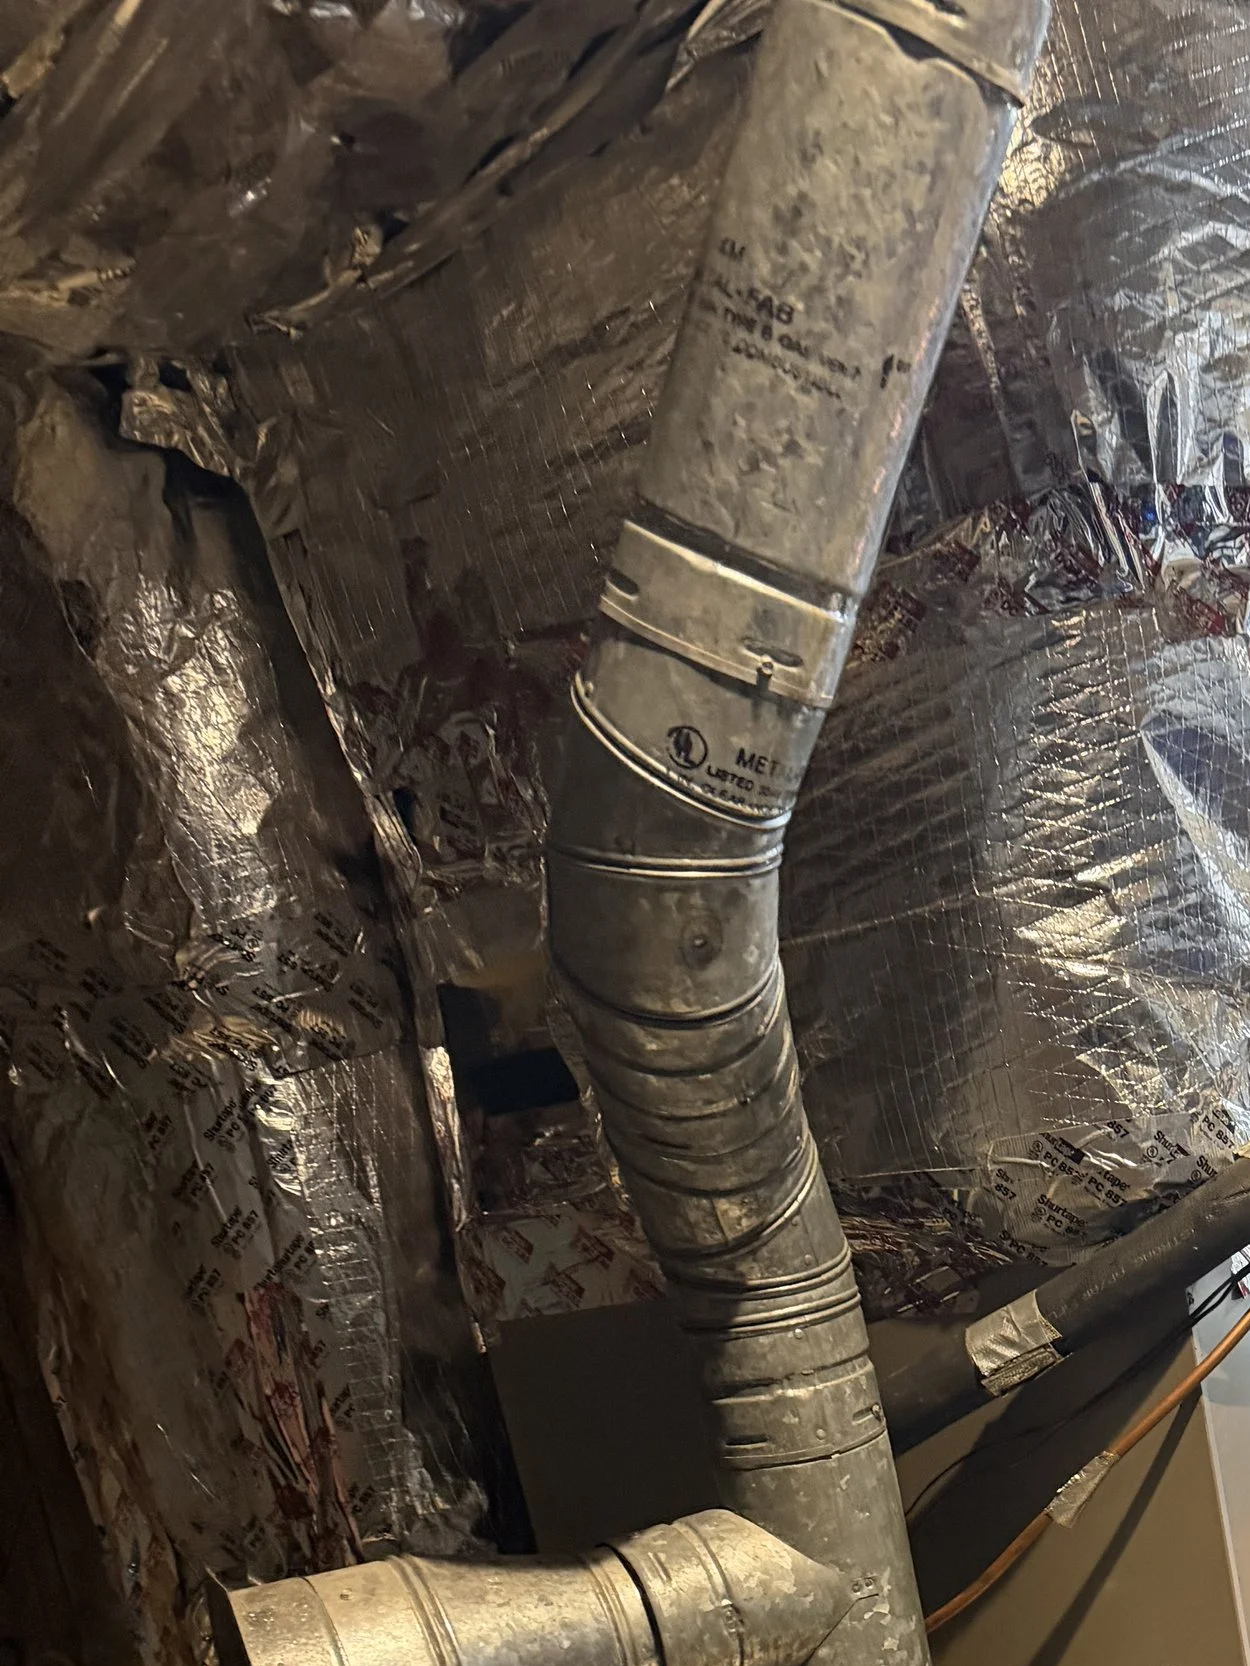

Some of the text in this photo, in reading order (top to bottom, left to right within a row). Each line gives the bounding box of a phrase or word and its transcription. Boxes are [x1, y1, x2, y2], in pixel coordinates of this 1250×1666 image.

[1202, 1115, 1235, 1149] PC 857
[1044, 1151, 1059, 1167] PC
[994, 1184, 1016, 1201] 857
[1088, 1176, 1127, 1208] PC 857
[1038, 1194, 1087, 1227] Shurtape
[1046, 1215, 1063, 1228] PC
